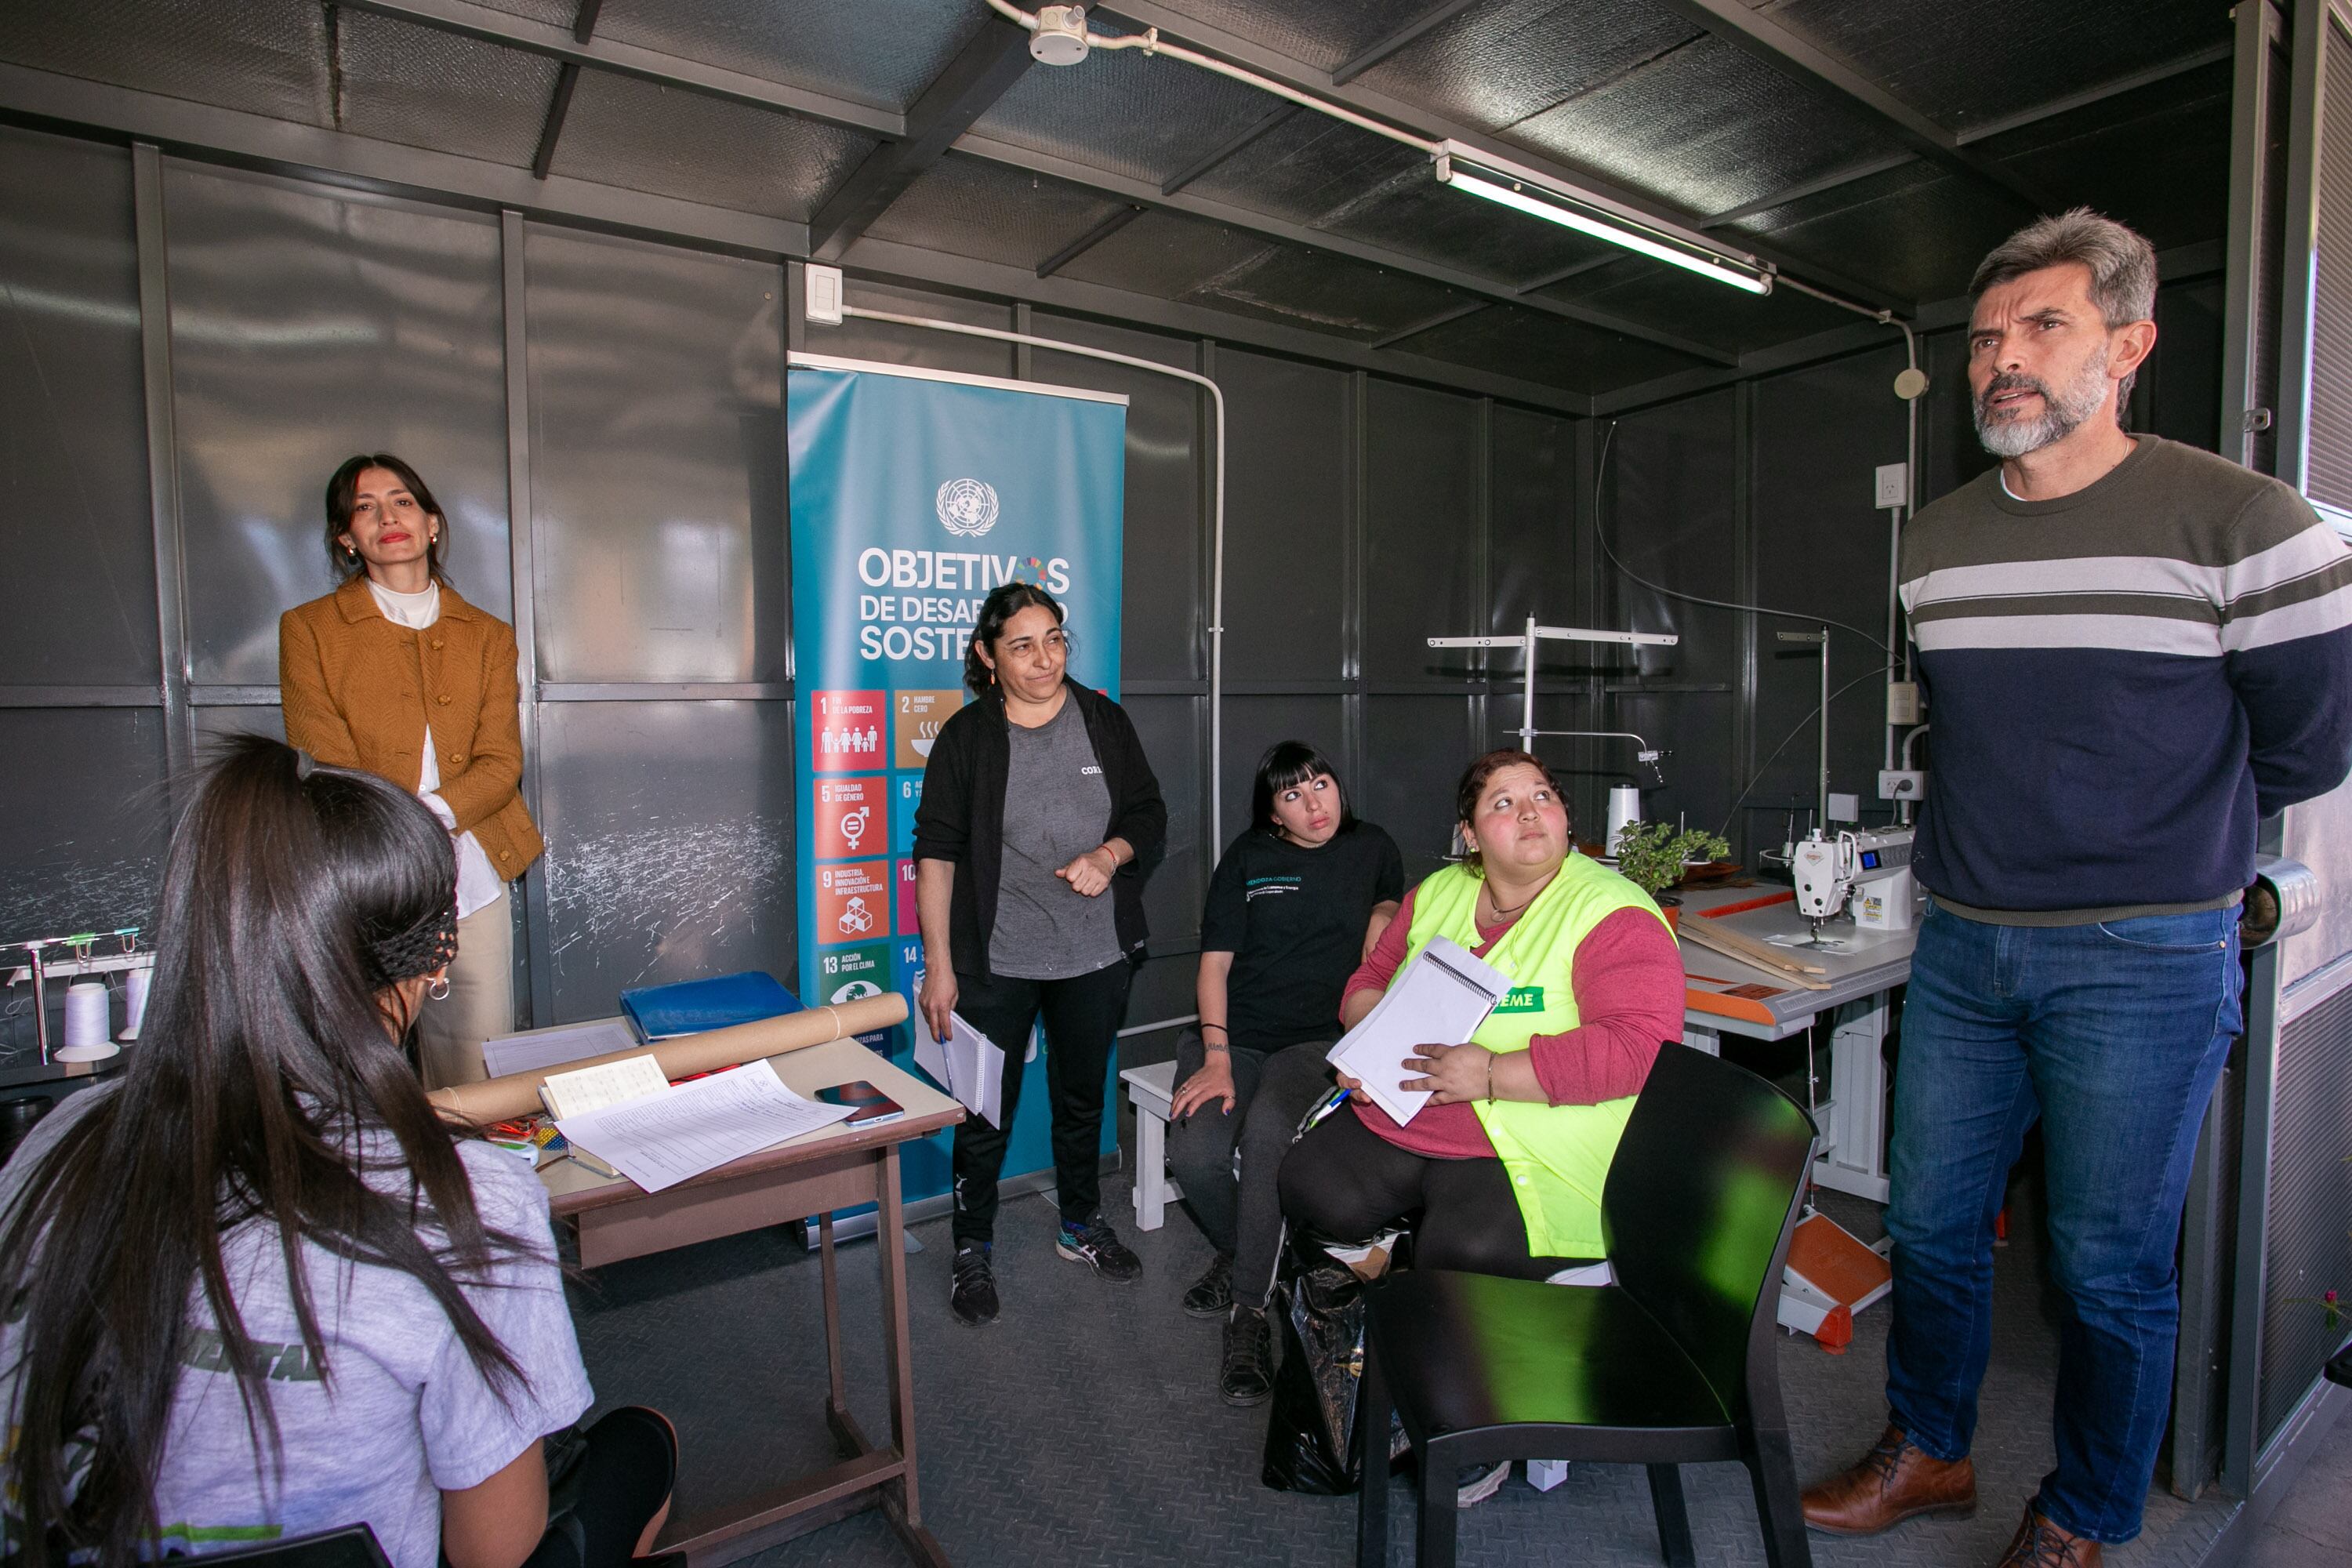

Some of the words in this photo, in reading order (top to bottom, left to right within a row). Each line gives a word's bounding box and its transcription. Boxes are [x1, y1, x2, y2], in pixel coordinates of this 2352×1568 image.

[858, 548, 1069, 593] OBJETIVOS
[860, 595, 895, 621] DE
[820, 697, 826, 714] 1
[833, 706, 840, 714] DE
[902, 696, 909, 713] 2
[822, 785, 830, 802] 5
[834, 784, 862, 793] IGUALDAD
[903, 782, 911, 798] 6
[835, 793, 843, 802] DE
[844, 793, 864, 801] GÉNERO
[822, 870, 831, 888] 9
[835, 869, 864, 878] INDUSTRIA,
[902, 865, 916, 881] 10
[835, 877, 866, 887] INNOVACIÓN
[835, 884, 884, 895] INFRAESTRUCTURA
[841, 953, 861, 963] ACCIÓN
[904, 946, 917, 964] 14
[823, 956, 838, 974] 13
[841, 964, 852, 972] POR
[859, 960, 875, 970] CLIMA
[1496, 993, 1534, 1007] EME
[869, 1033, 884, 1042] PARA
